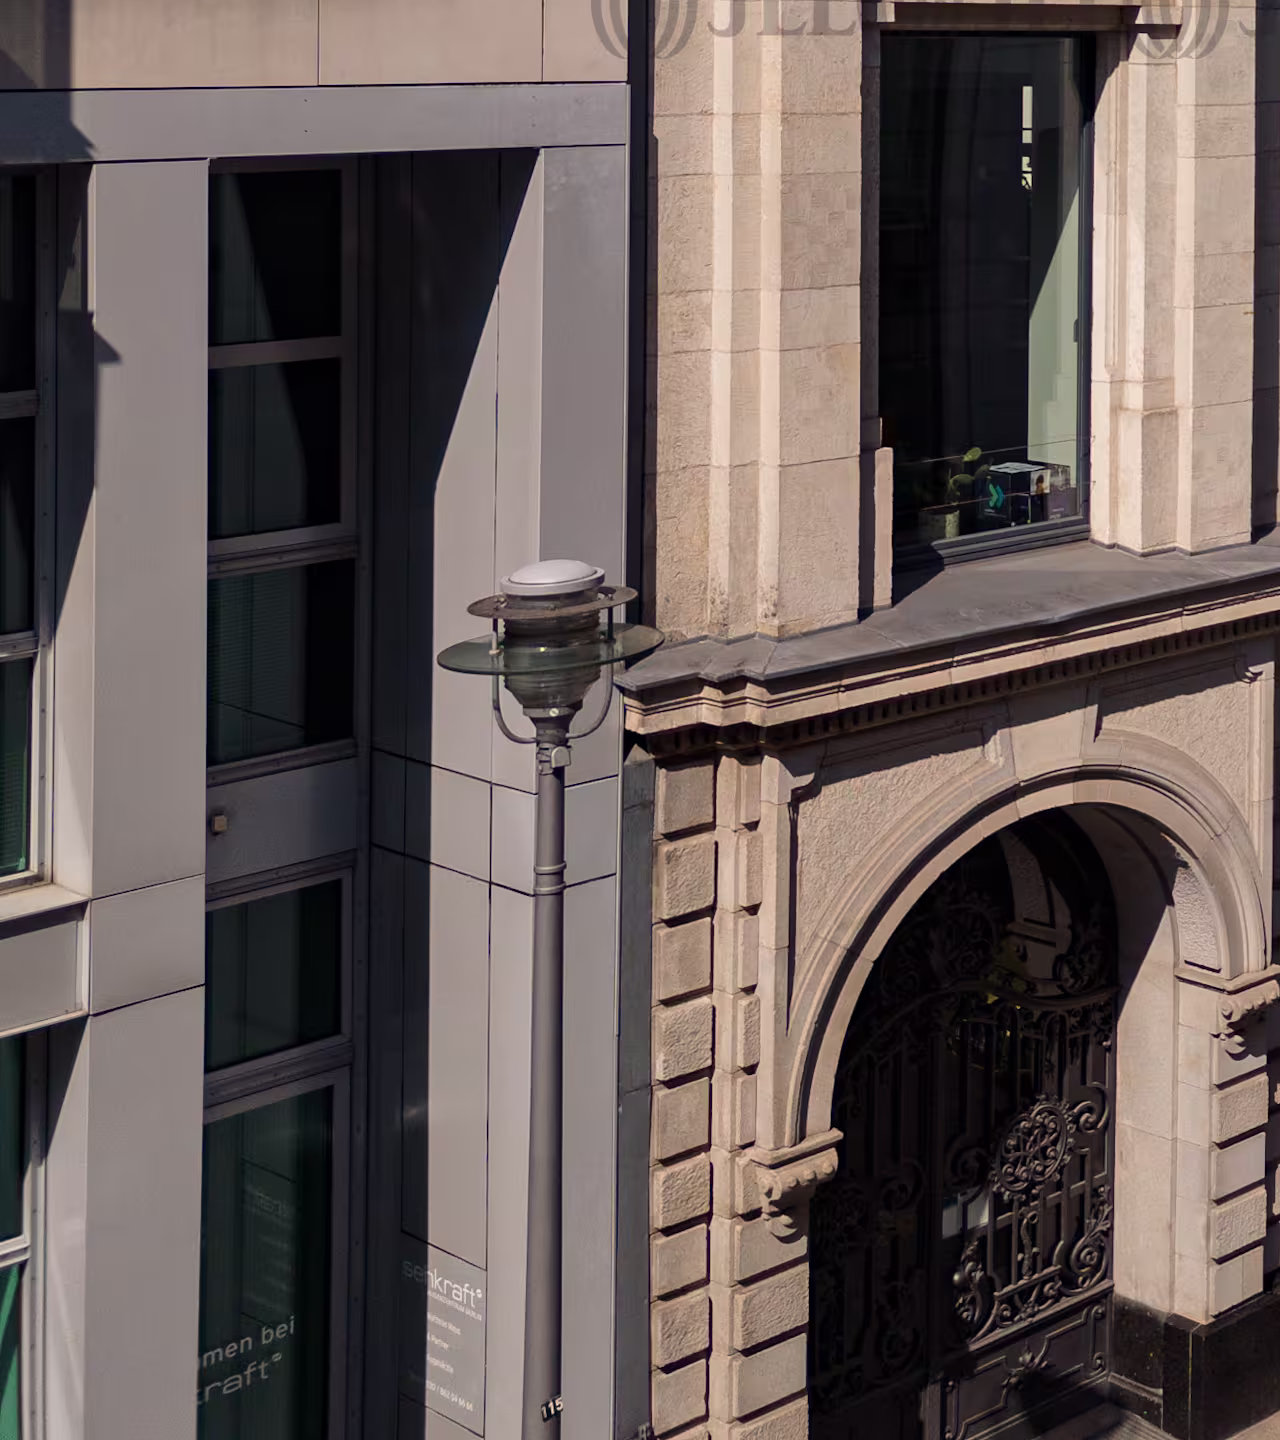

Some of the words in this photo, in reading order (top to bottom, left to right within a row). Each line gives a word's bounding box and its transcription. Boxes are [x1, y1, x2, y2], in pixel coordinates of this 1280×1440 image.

[198, 1336, 253, 1368] men
[261, 1315, 295, 1345] bei
[541, 1396, 564, 1418] 115
